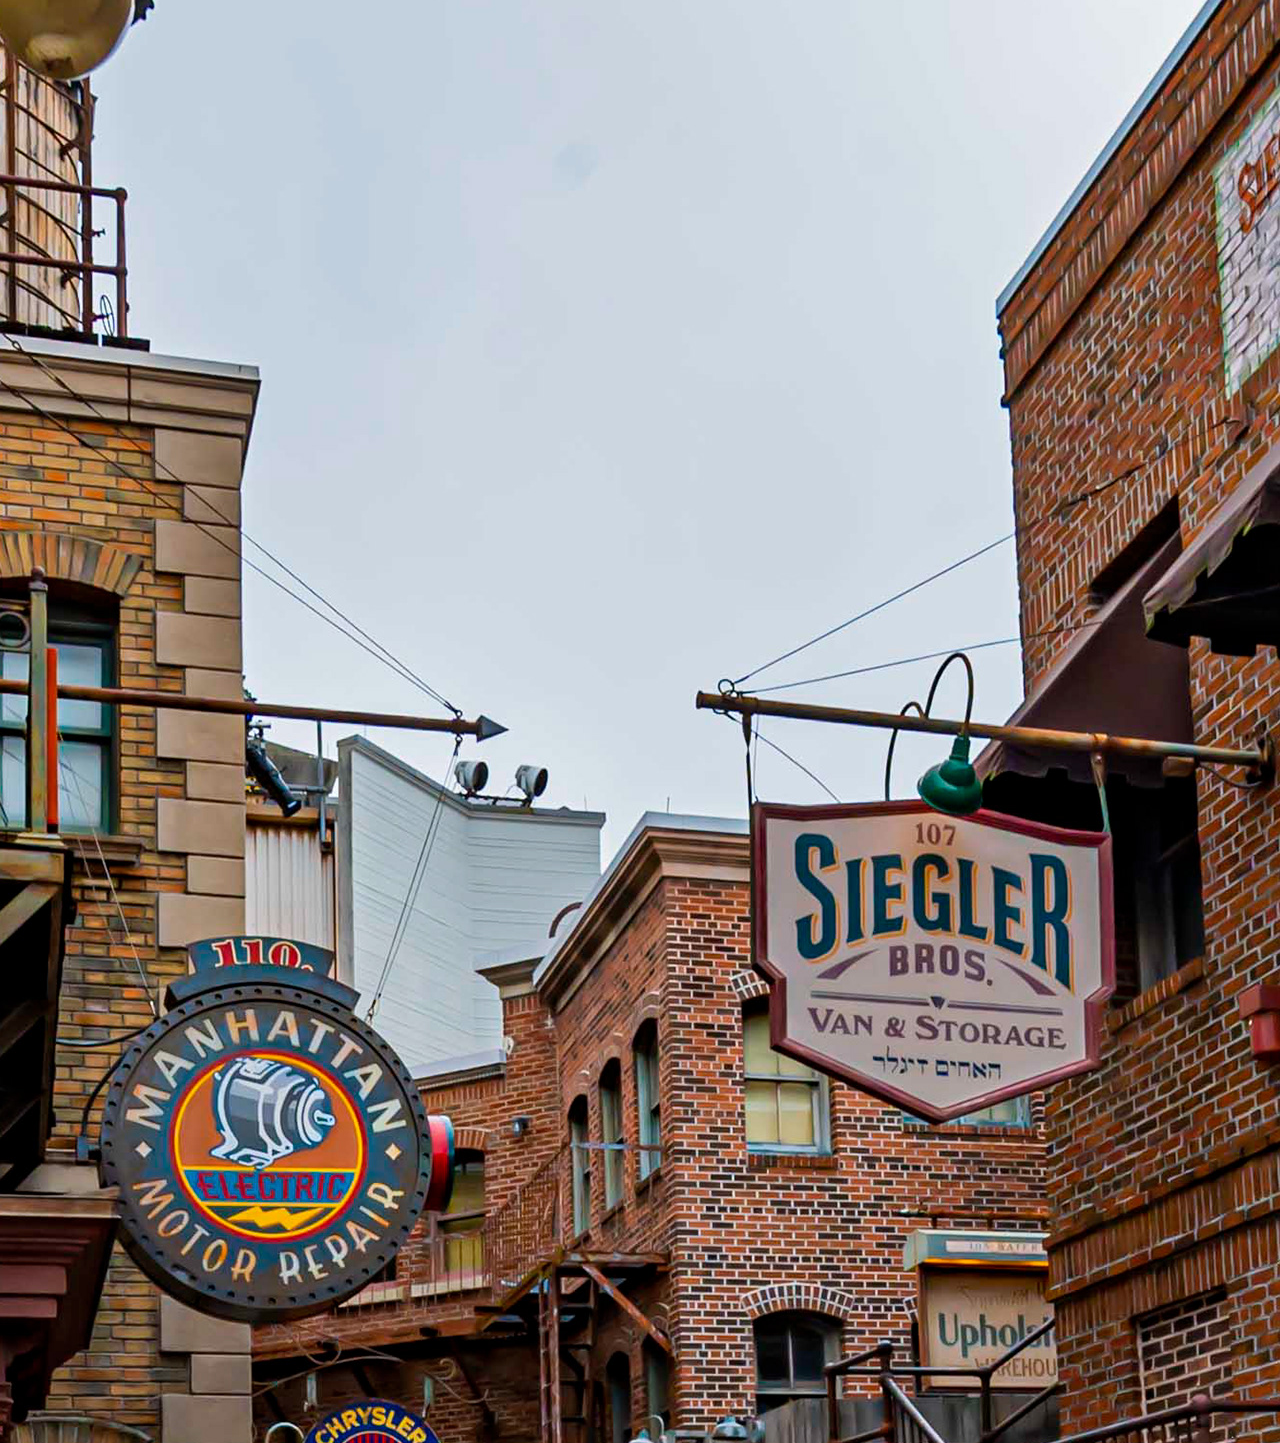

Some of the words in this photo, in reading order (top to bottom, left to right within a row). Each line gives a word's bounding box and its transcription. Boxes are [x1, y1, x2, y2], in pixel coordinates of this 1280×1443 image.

[915, 823, 956, 846] 107
[794, 833, 1075, 997] SIEGLER
[888, 943, 993, 987] BROS.
[807, 1007, 874, 1037] VAN
[884, 1017, 906, 1040] &
[915, 1015, 1067, 1050] STORAGE
[125, 1008, 407, 1134] MANHATTAN
[197, 1170, 346, 1201] ELECTRIC
[133, 1178, 257, 1283] MOTOR
[278, 1182, 405, 1285] REPAIR
[937, 1312, 1056, 1358] Upholst
[974, 1358, 1057, 1377] WREHOU
